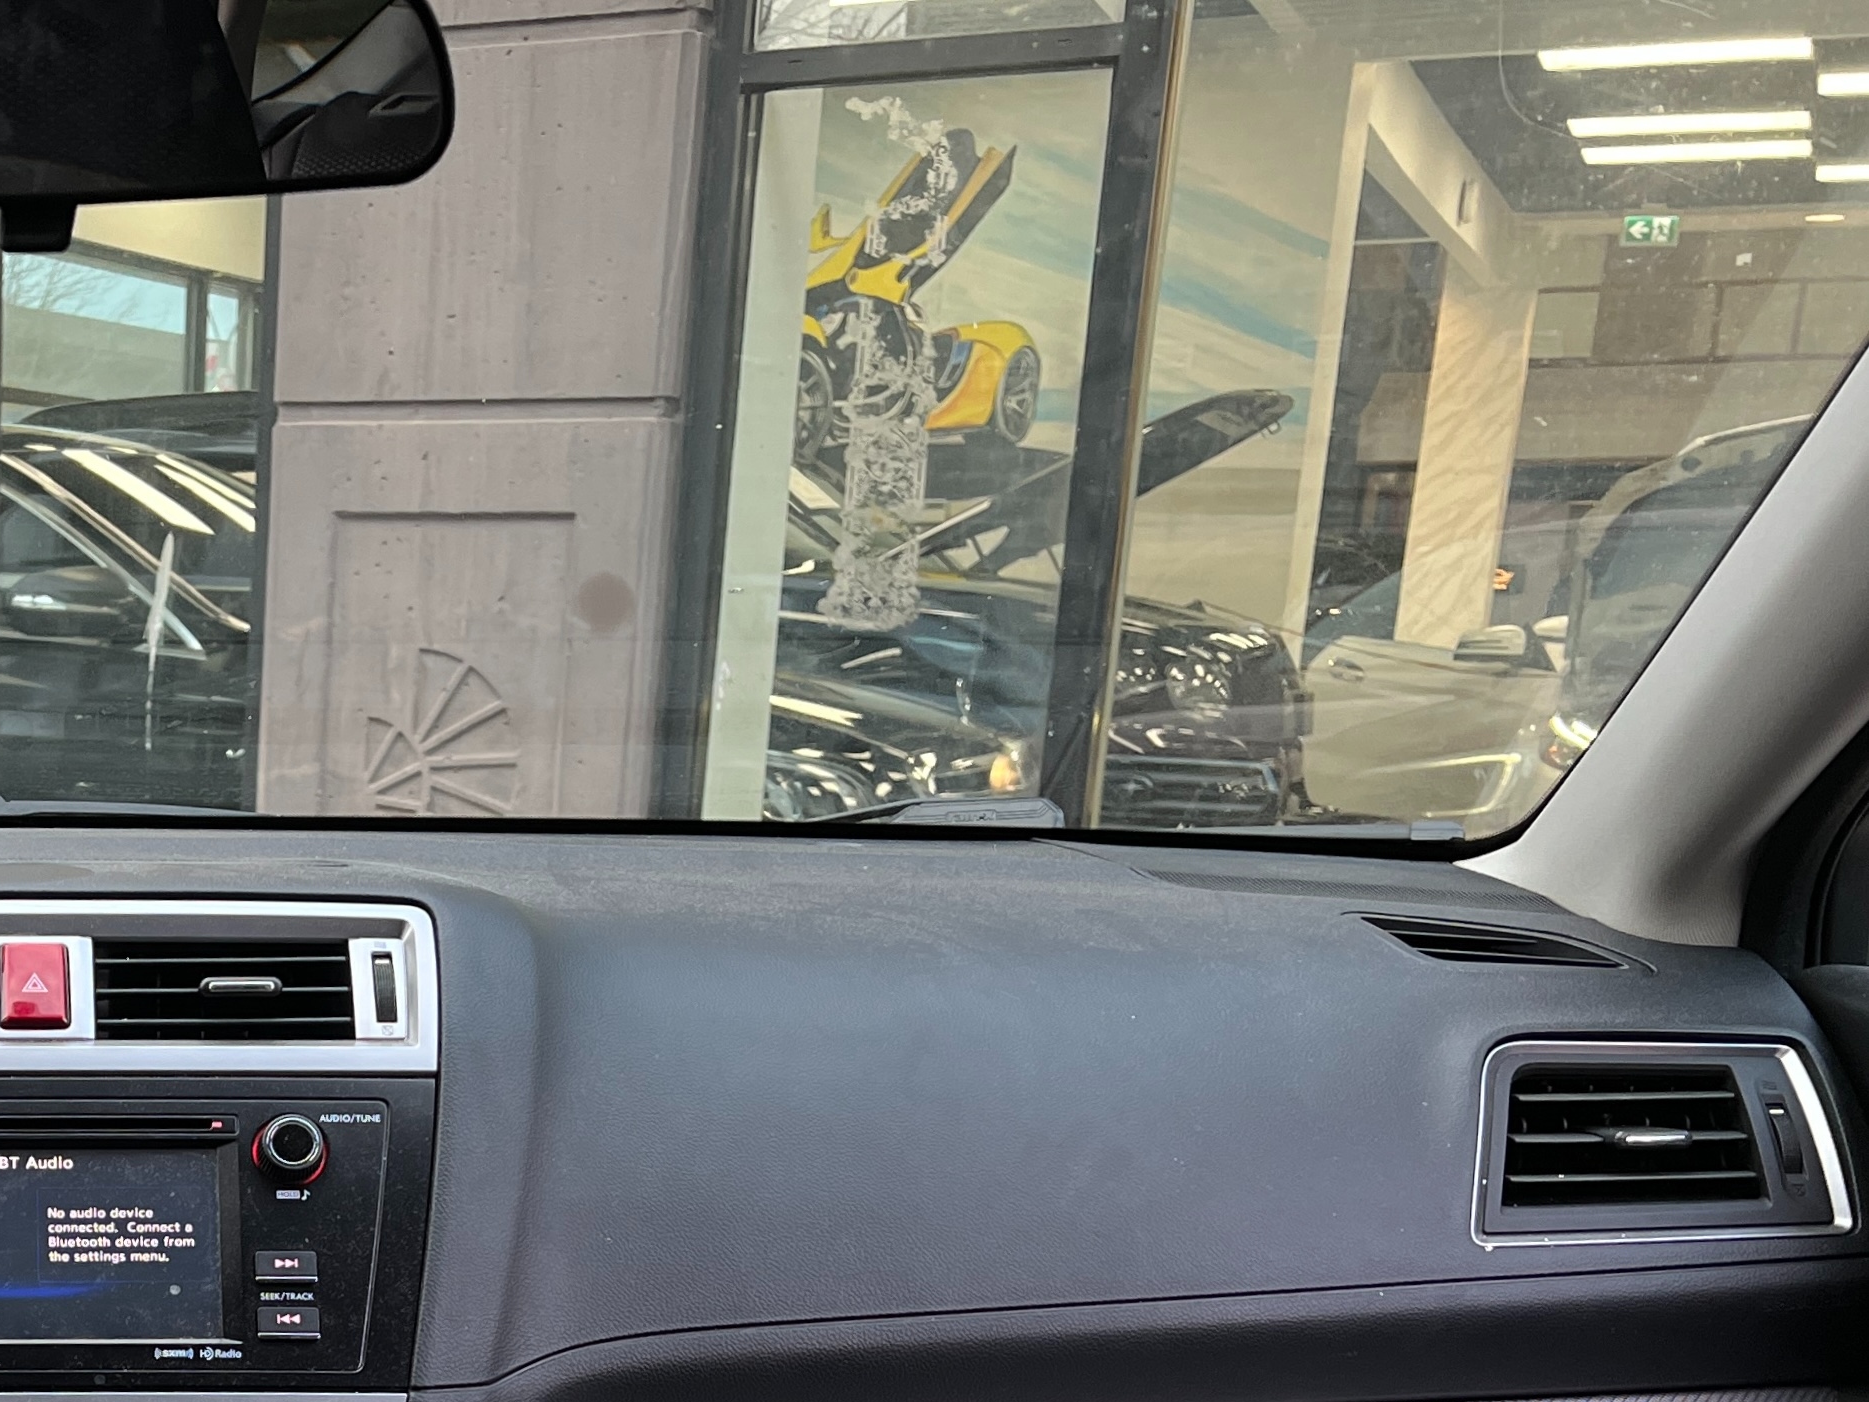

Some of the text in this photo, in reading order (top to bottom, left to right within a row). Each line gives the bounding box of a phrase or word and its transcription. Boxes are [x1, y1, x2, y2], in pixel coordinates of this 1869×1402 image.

[319, 1114, 381, 1123] AUDIO/TUNE
[26, 1156, 74, 1170] Audio
[47, 1207, 153, 1218] No audio device
[47, 1222, 193, 1234] connected. Connect a
[48, 1236, 195, 1248] Bluetooth device from
[48, 1251, 170, 1264] the settings menu.
[260, 1292, 314, 1301] SEEK/TRACK
[214, 1349, 242, 1359] Radio
